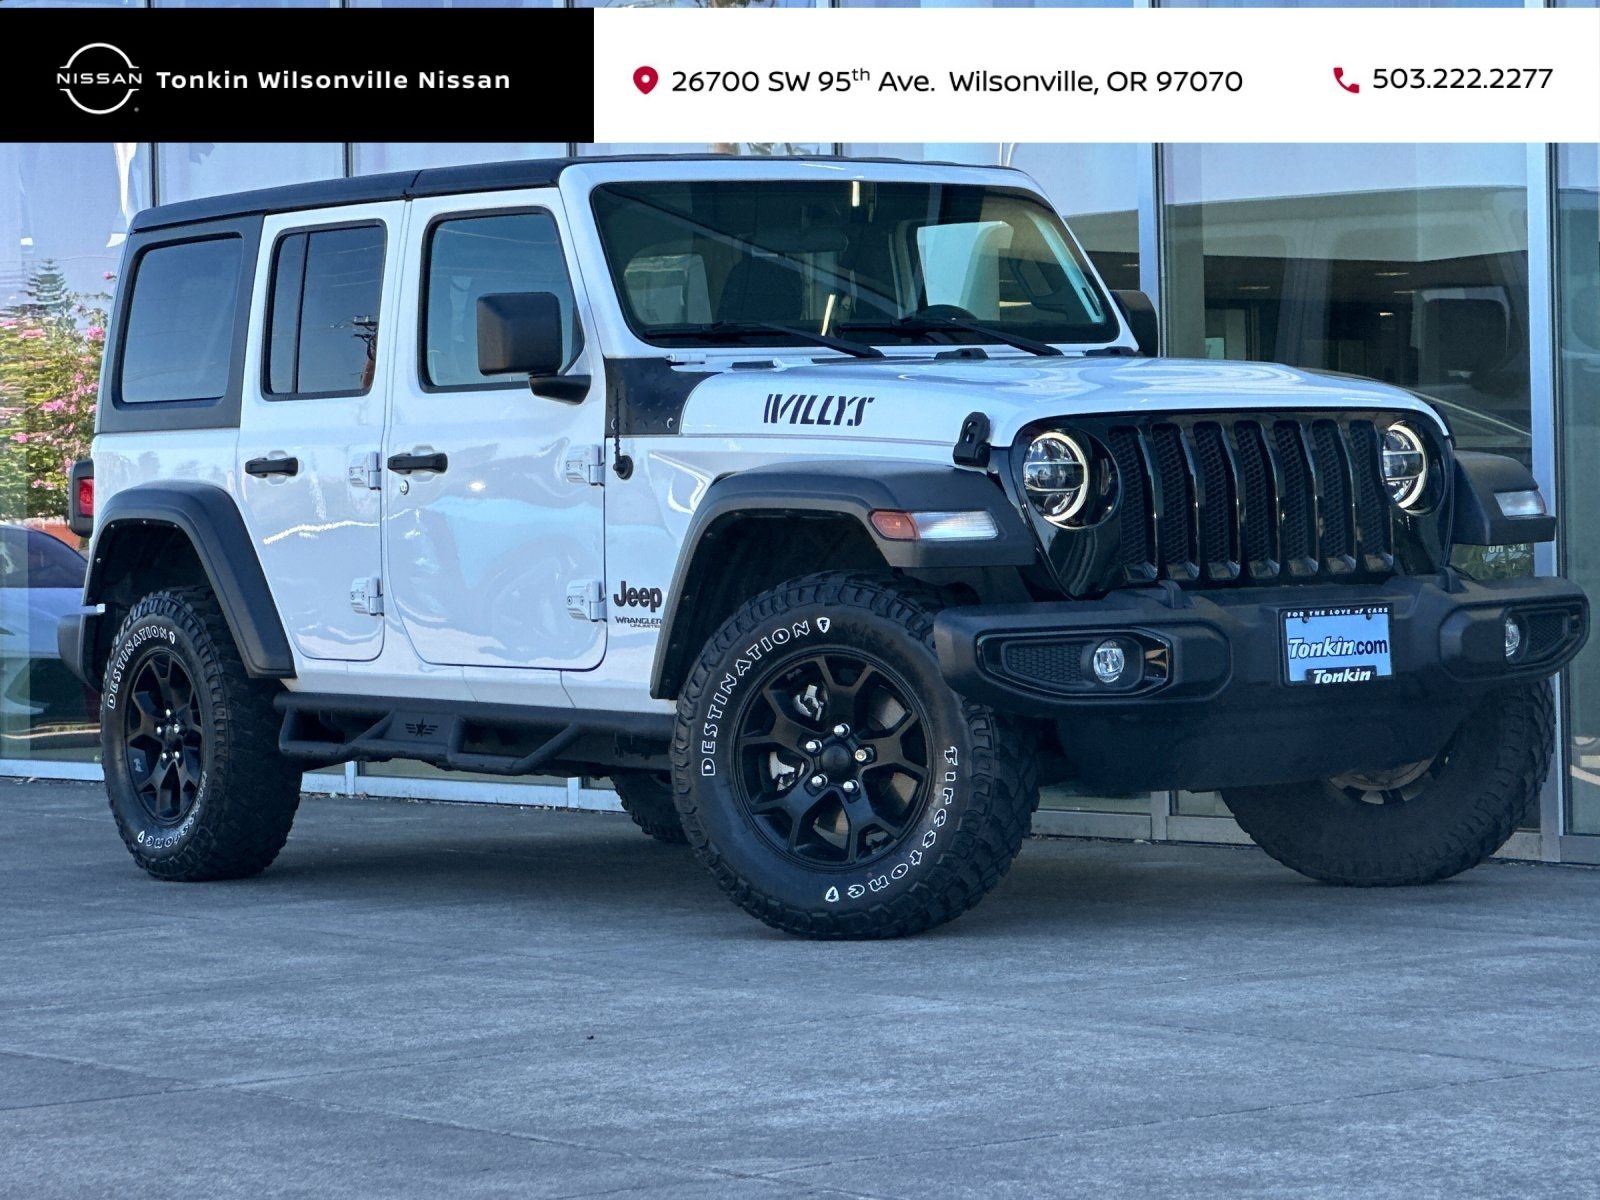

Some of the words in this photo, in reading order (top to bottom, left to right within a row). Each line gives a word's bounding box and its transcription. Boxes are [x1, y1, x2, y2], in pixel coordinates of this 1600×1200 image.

[763, 394, 875, 427] WILLYS
[613, 580, 663, 613] Jeep
[1289, 636, 1388, 659] Tonkin.com
[107, 625, 168, 710] DESTINATION
[1313, 668, 1371, 685] Tonkin
[702, 620, 810, 777] DESTINATION
[847, 746, 958, 899] Firestone
